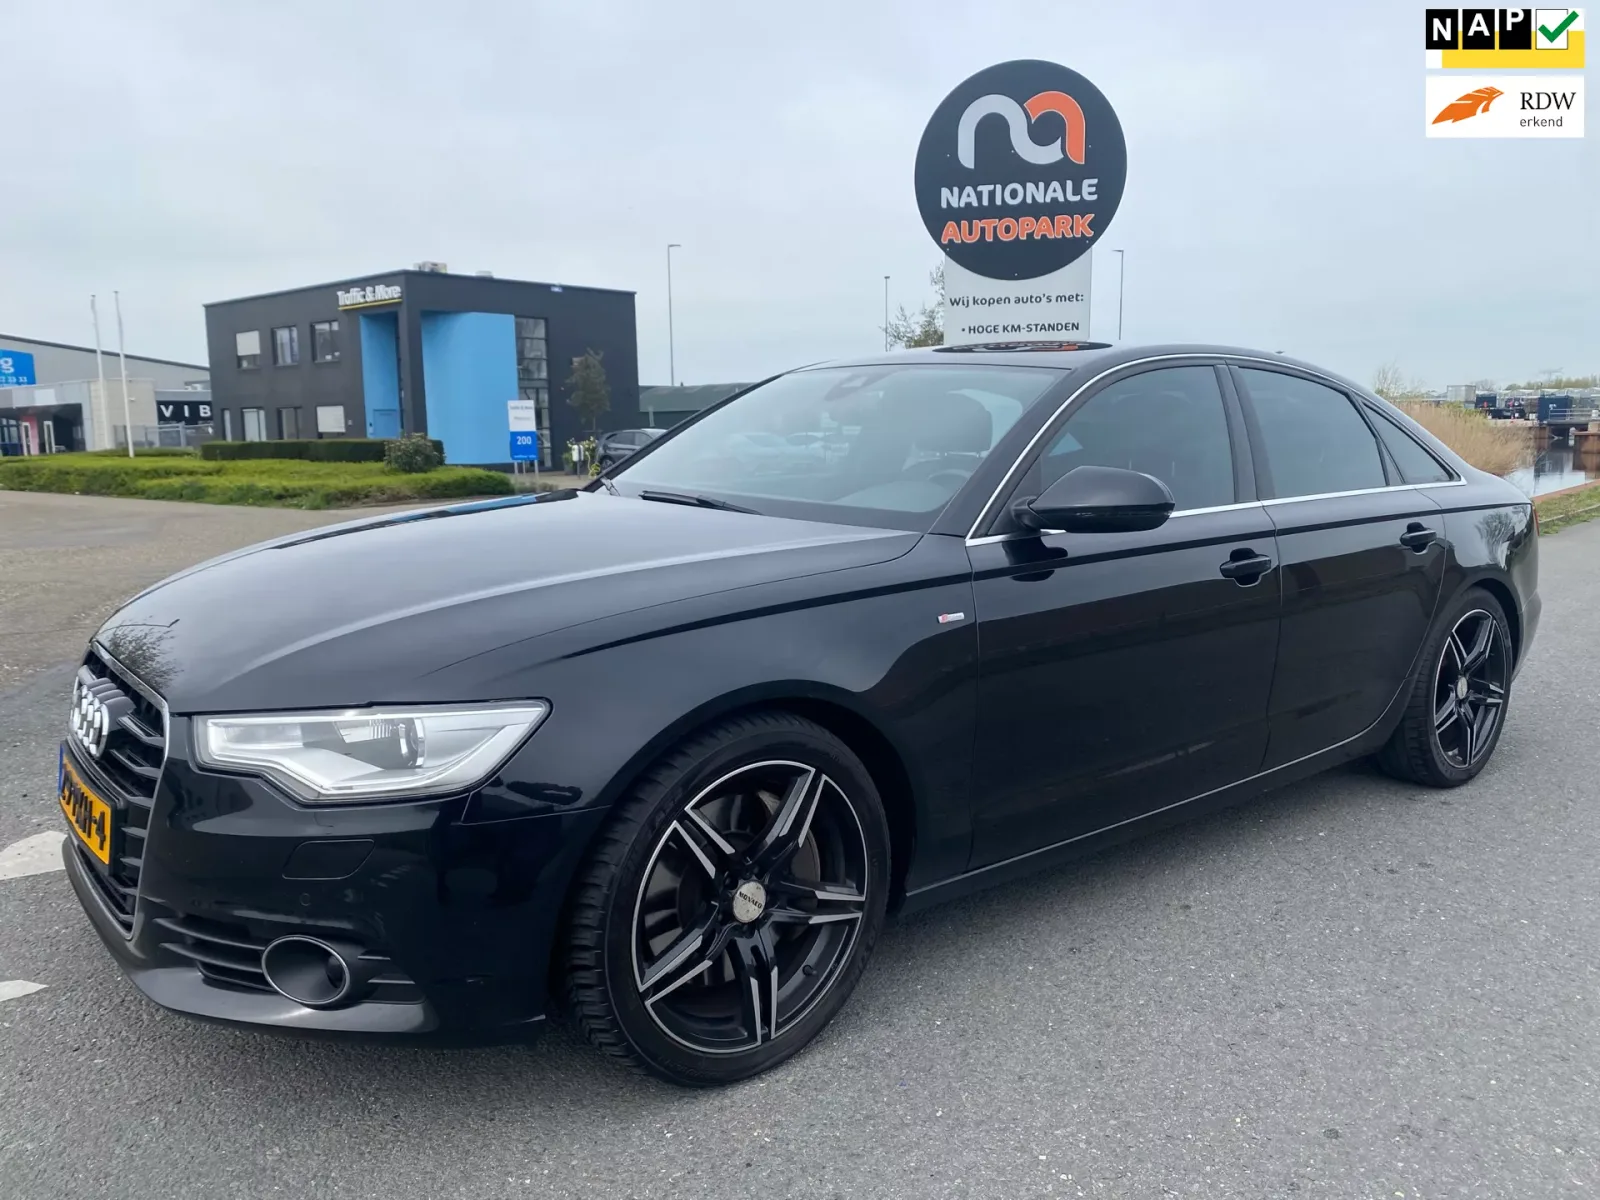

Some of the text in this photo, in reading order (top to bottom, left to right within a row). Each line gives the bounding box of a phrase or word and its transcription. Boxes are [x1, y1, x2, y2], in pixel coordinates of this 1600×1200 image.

[940, 178, 1098, 209] NATIONALE
[940, 213, 1095, 244] AUTOPARK
[365, 286, 375, 302] &
[949, 293, 1084, 308] Wij kopen auto's met:
[968, 322, 1080, 334] HOGE KM-STANDEN
[516, 436, 532, 445] 200
